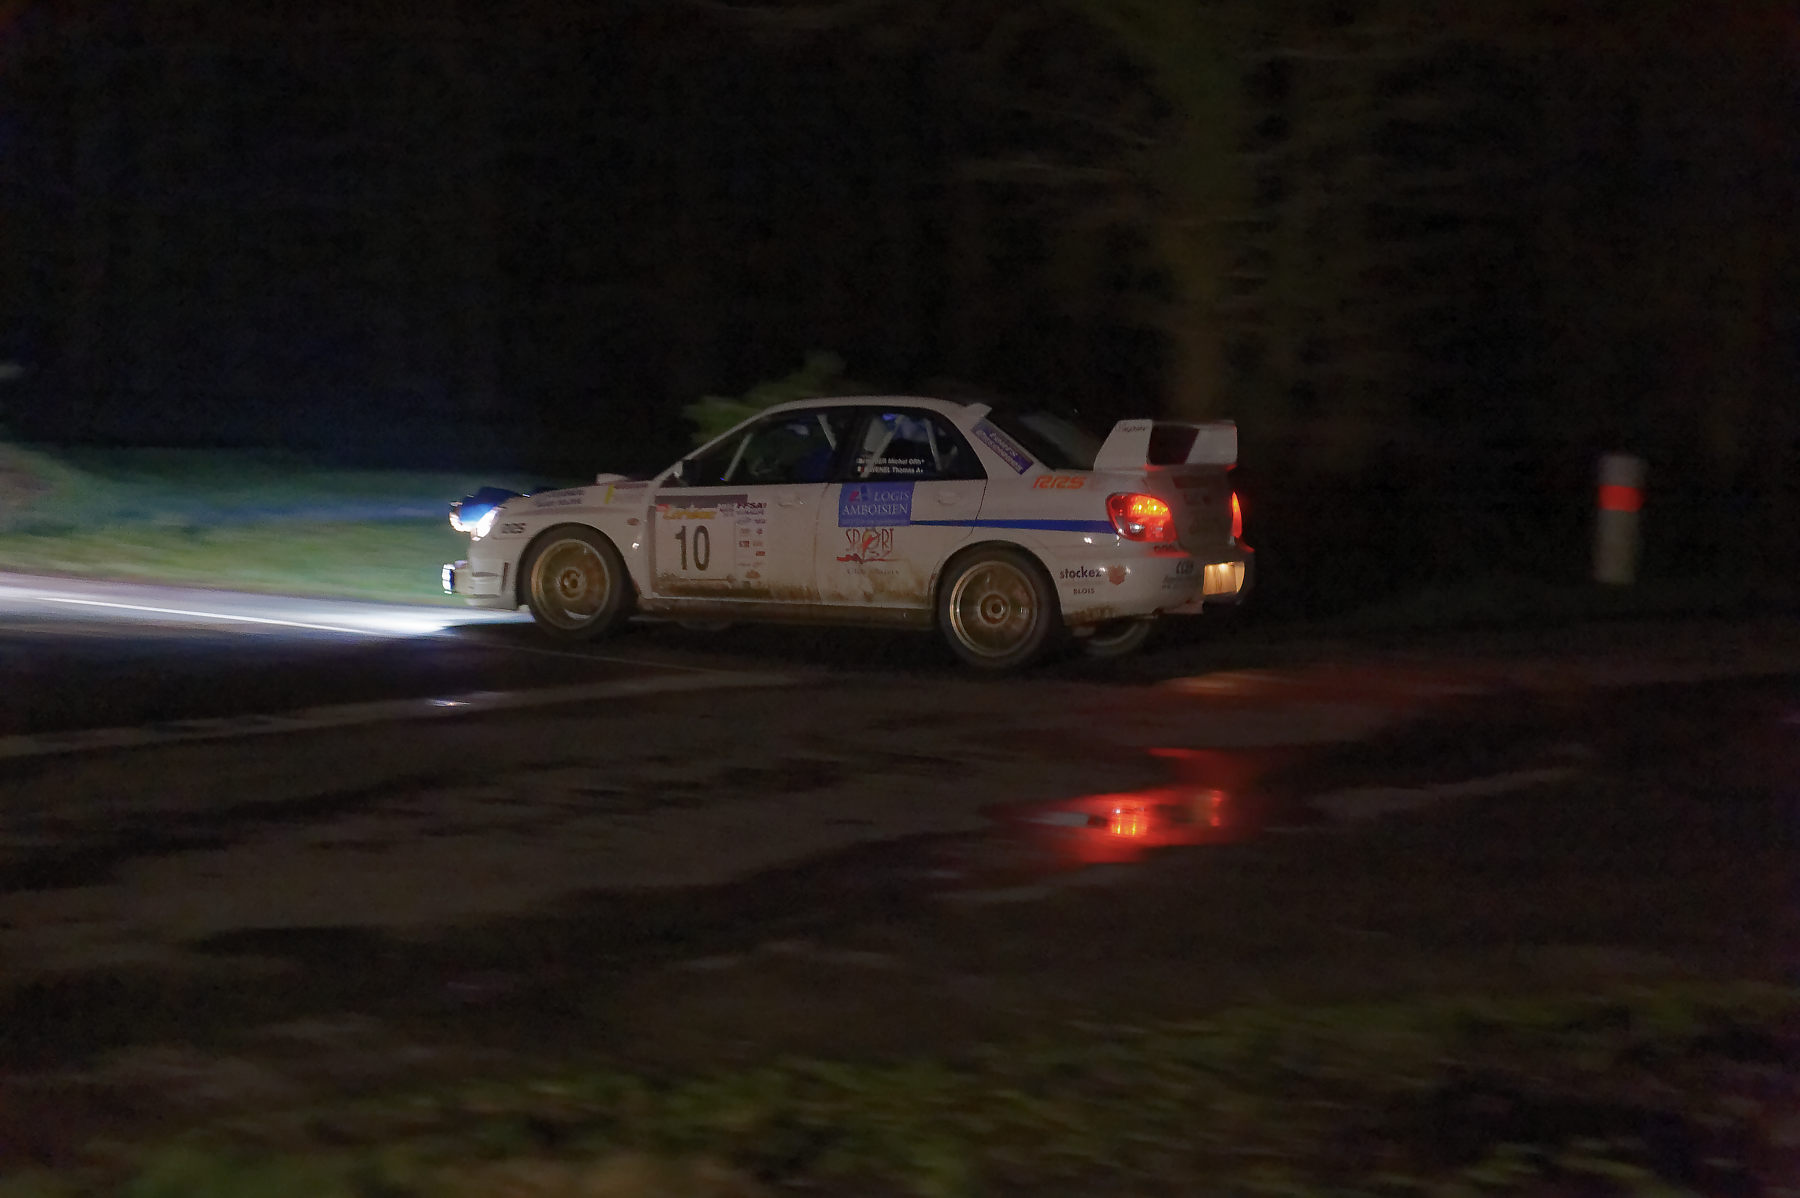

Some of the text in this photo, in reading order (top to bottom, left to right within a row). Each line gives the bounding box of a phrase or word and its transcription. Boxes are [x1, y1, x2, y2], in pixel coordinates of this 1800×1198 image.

[892, 465, 915, 473] Thomas
[874, 490, 910, 501] LOGIS
[842, 503, 909, 516] AMBOISIEN
[674, 525, 710, 571] 10
